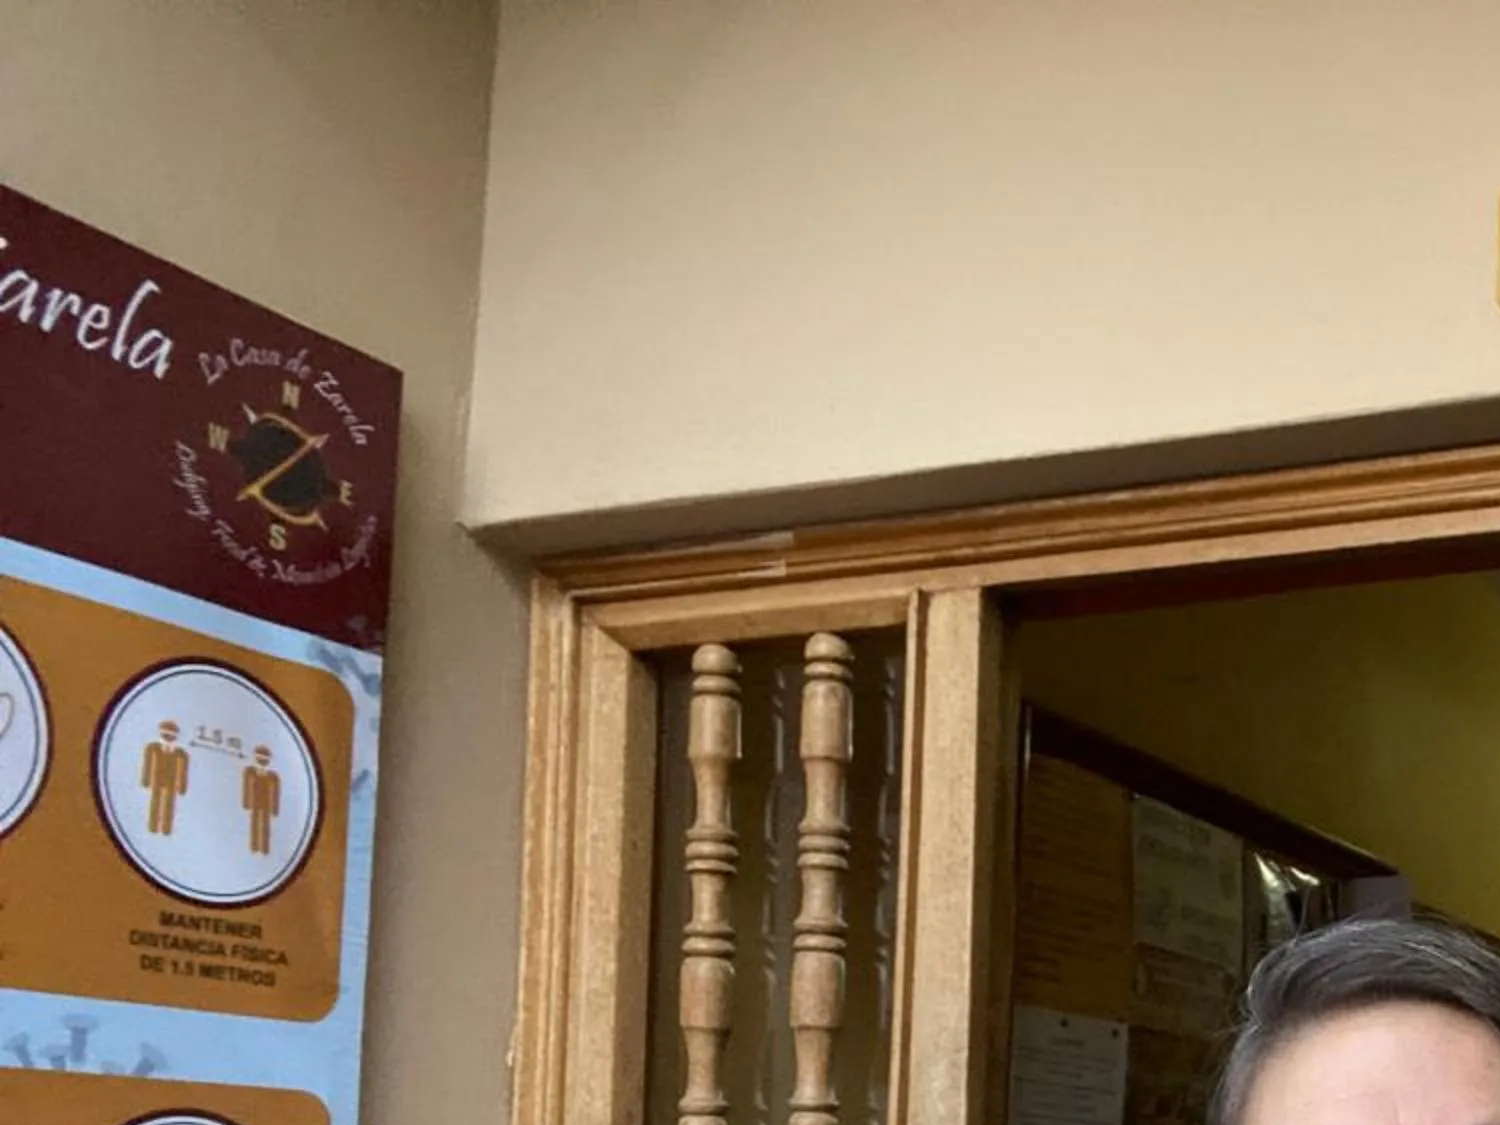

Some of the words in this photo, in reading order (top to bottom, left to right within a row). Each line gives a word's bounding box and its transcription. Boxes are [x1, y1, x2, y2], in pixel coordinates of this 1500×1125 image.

[0, 266, 174, 380] arela
[284, 348, 312, 379] de
[281, 380, 301, 411] N
[207, 422, 230, 453] W
[339, 479, 354, 508] E
[268, 523, 288, 551] S
[159, 910, 262, 940] MANTENER
[129, 928, 227, 957] DISTANCIA
[140, 953, 165, 973] DE
[198, 963, 277, 988] METROS
